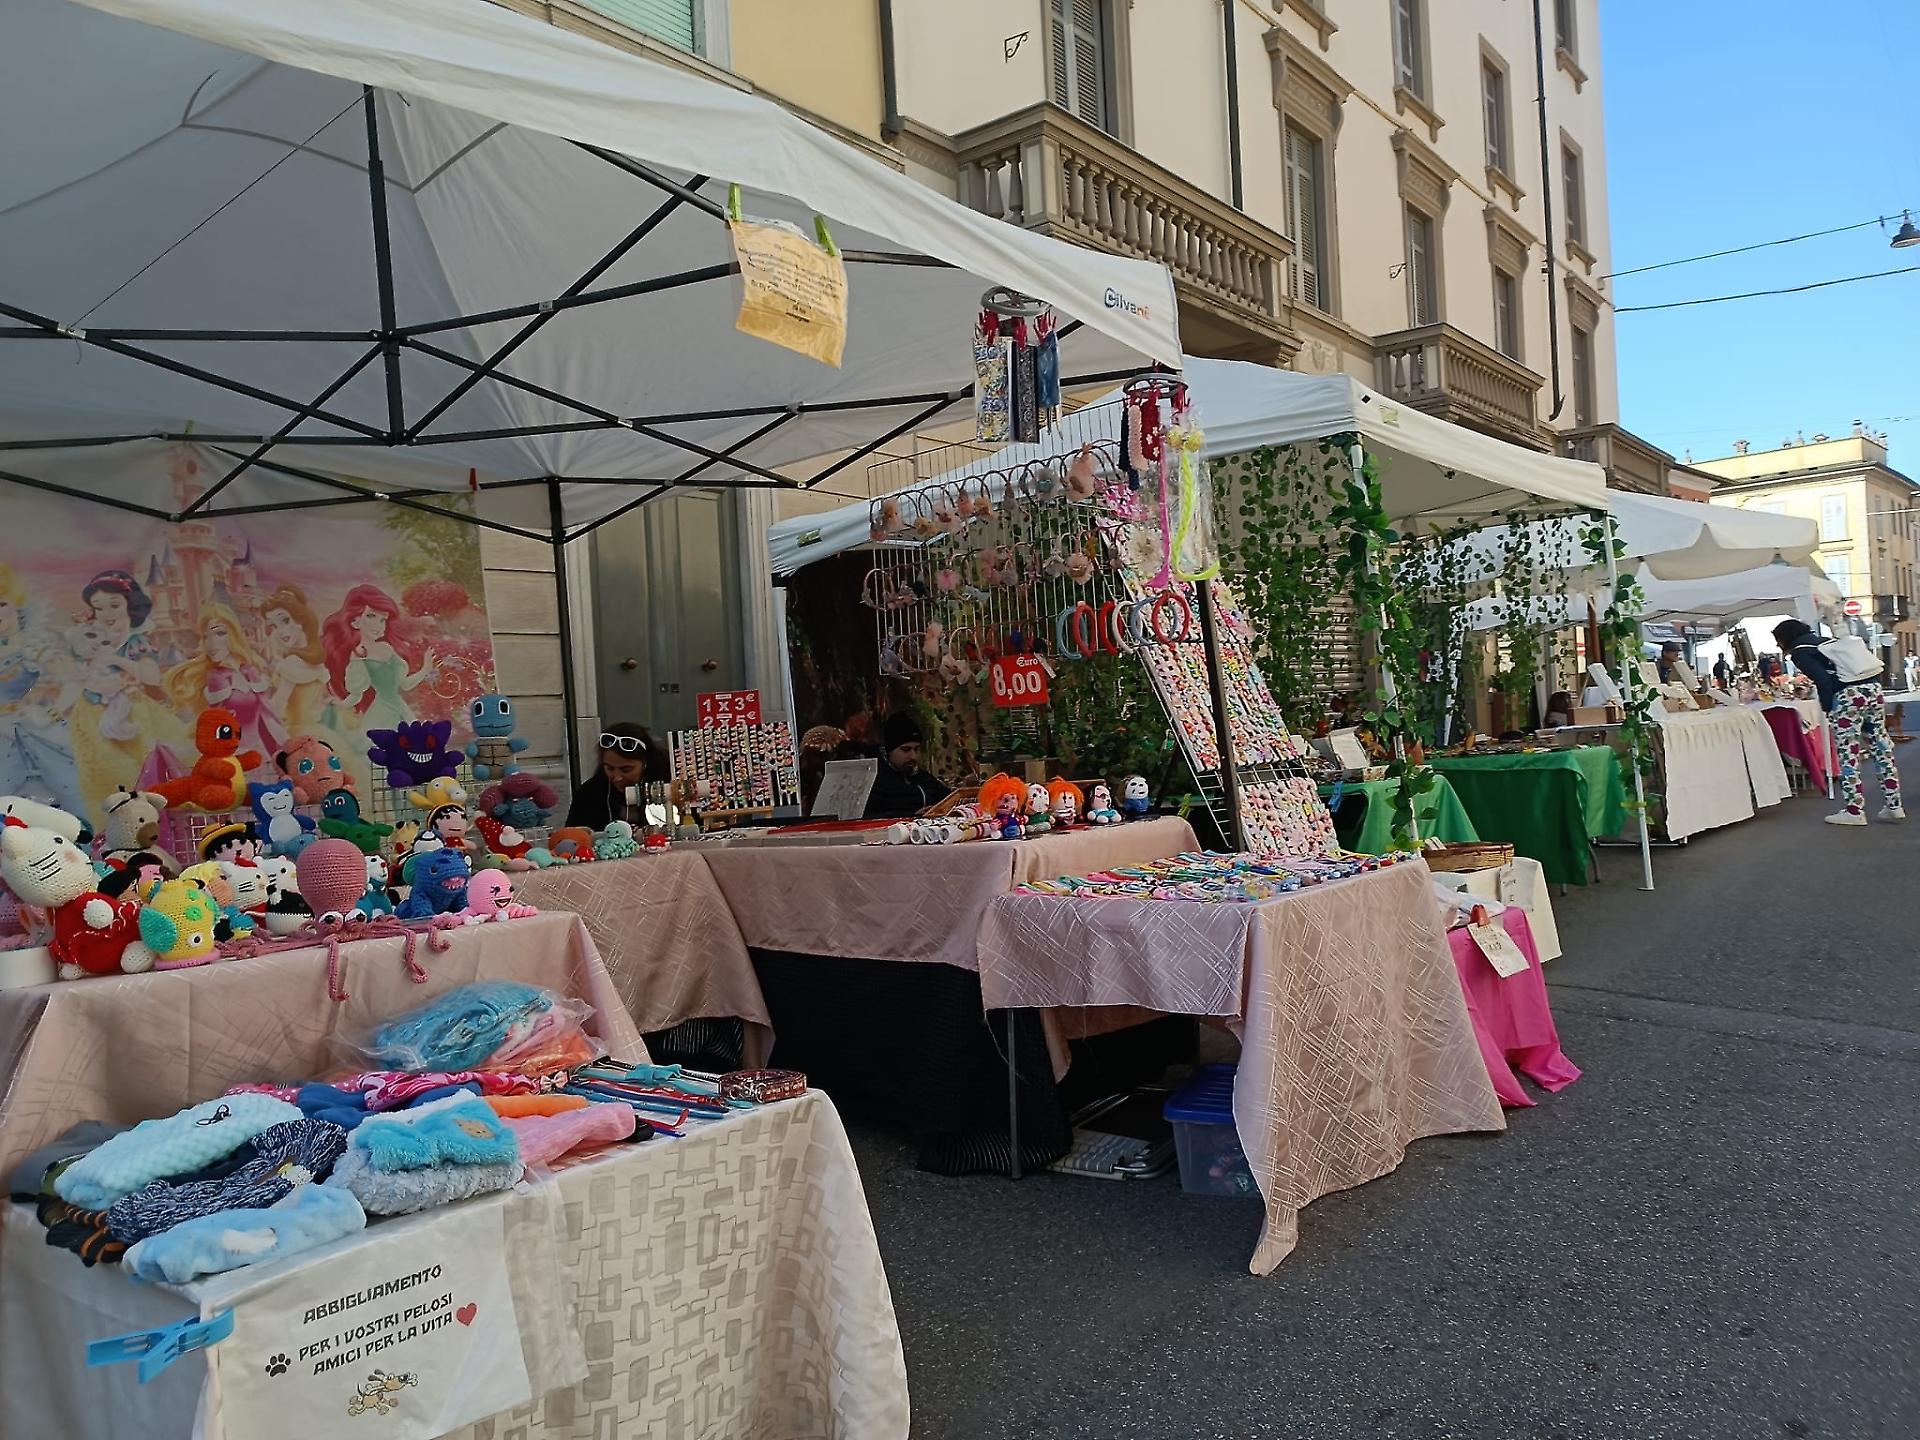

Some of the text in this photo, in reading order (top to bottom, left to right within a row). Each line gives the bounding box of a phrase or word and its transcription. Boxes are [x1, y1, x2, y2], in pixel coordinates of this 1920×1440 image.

[993, 663, 1041, 700] 8,00
[1016, 656, 1038, 667] Euro
[703, 698, 711, 712] 1
[303, 1264, 442, 1325] ABBIGLIAMENTO
[299, 1337, 332, 1362] PER
[335, 1334, 340, 1348] I
[403, 1292, 453, 1323] PELOSI
[313, 1311, 453, 1376] AMICI PER LA VITA
